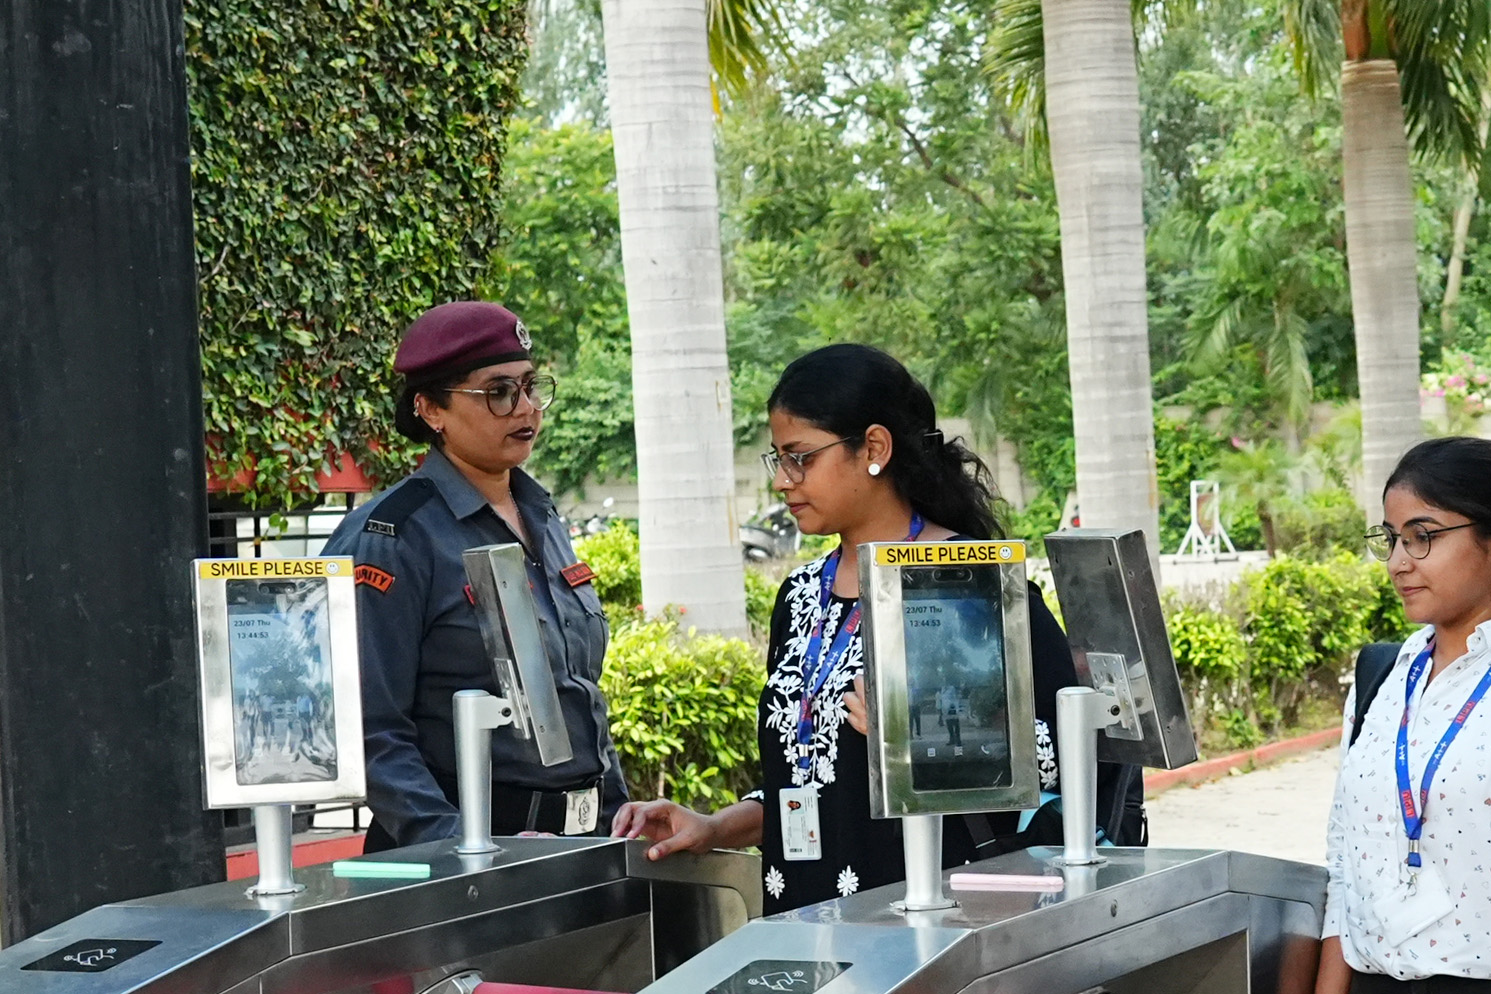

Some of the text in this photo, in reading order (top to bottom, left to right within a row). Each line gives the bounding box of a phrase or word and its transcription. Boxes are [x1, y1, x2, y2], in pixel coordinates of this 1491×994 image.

[887, 546, 997, 563] SMILE PLEASE
[211, 561, 324, 577] SMILE PLEASE
[355, 568, 388, 587] URITY
[906, 605, 943, 614] 23/07 Thu
[233, 619, 271, 628] 23/07 Thu
[909, 619, 941, 627] 13:44:53
[237, 631, 269, 640] 13:44:53
[1409, 665, 1421, 683] A++
